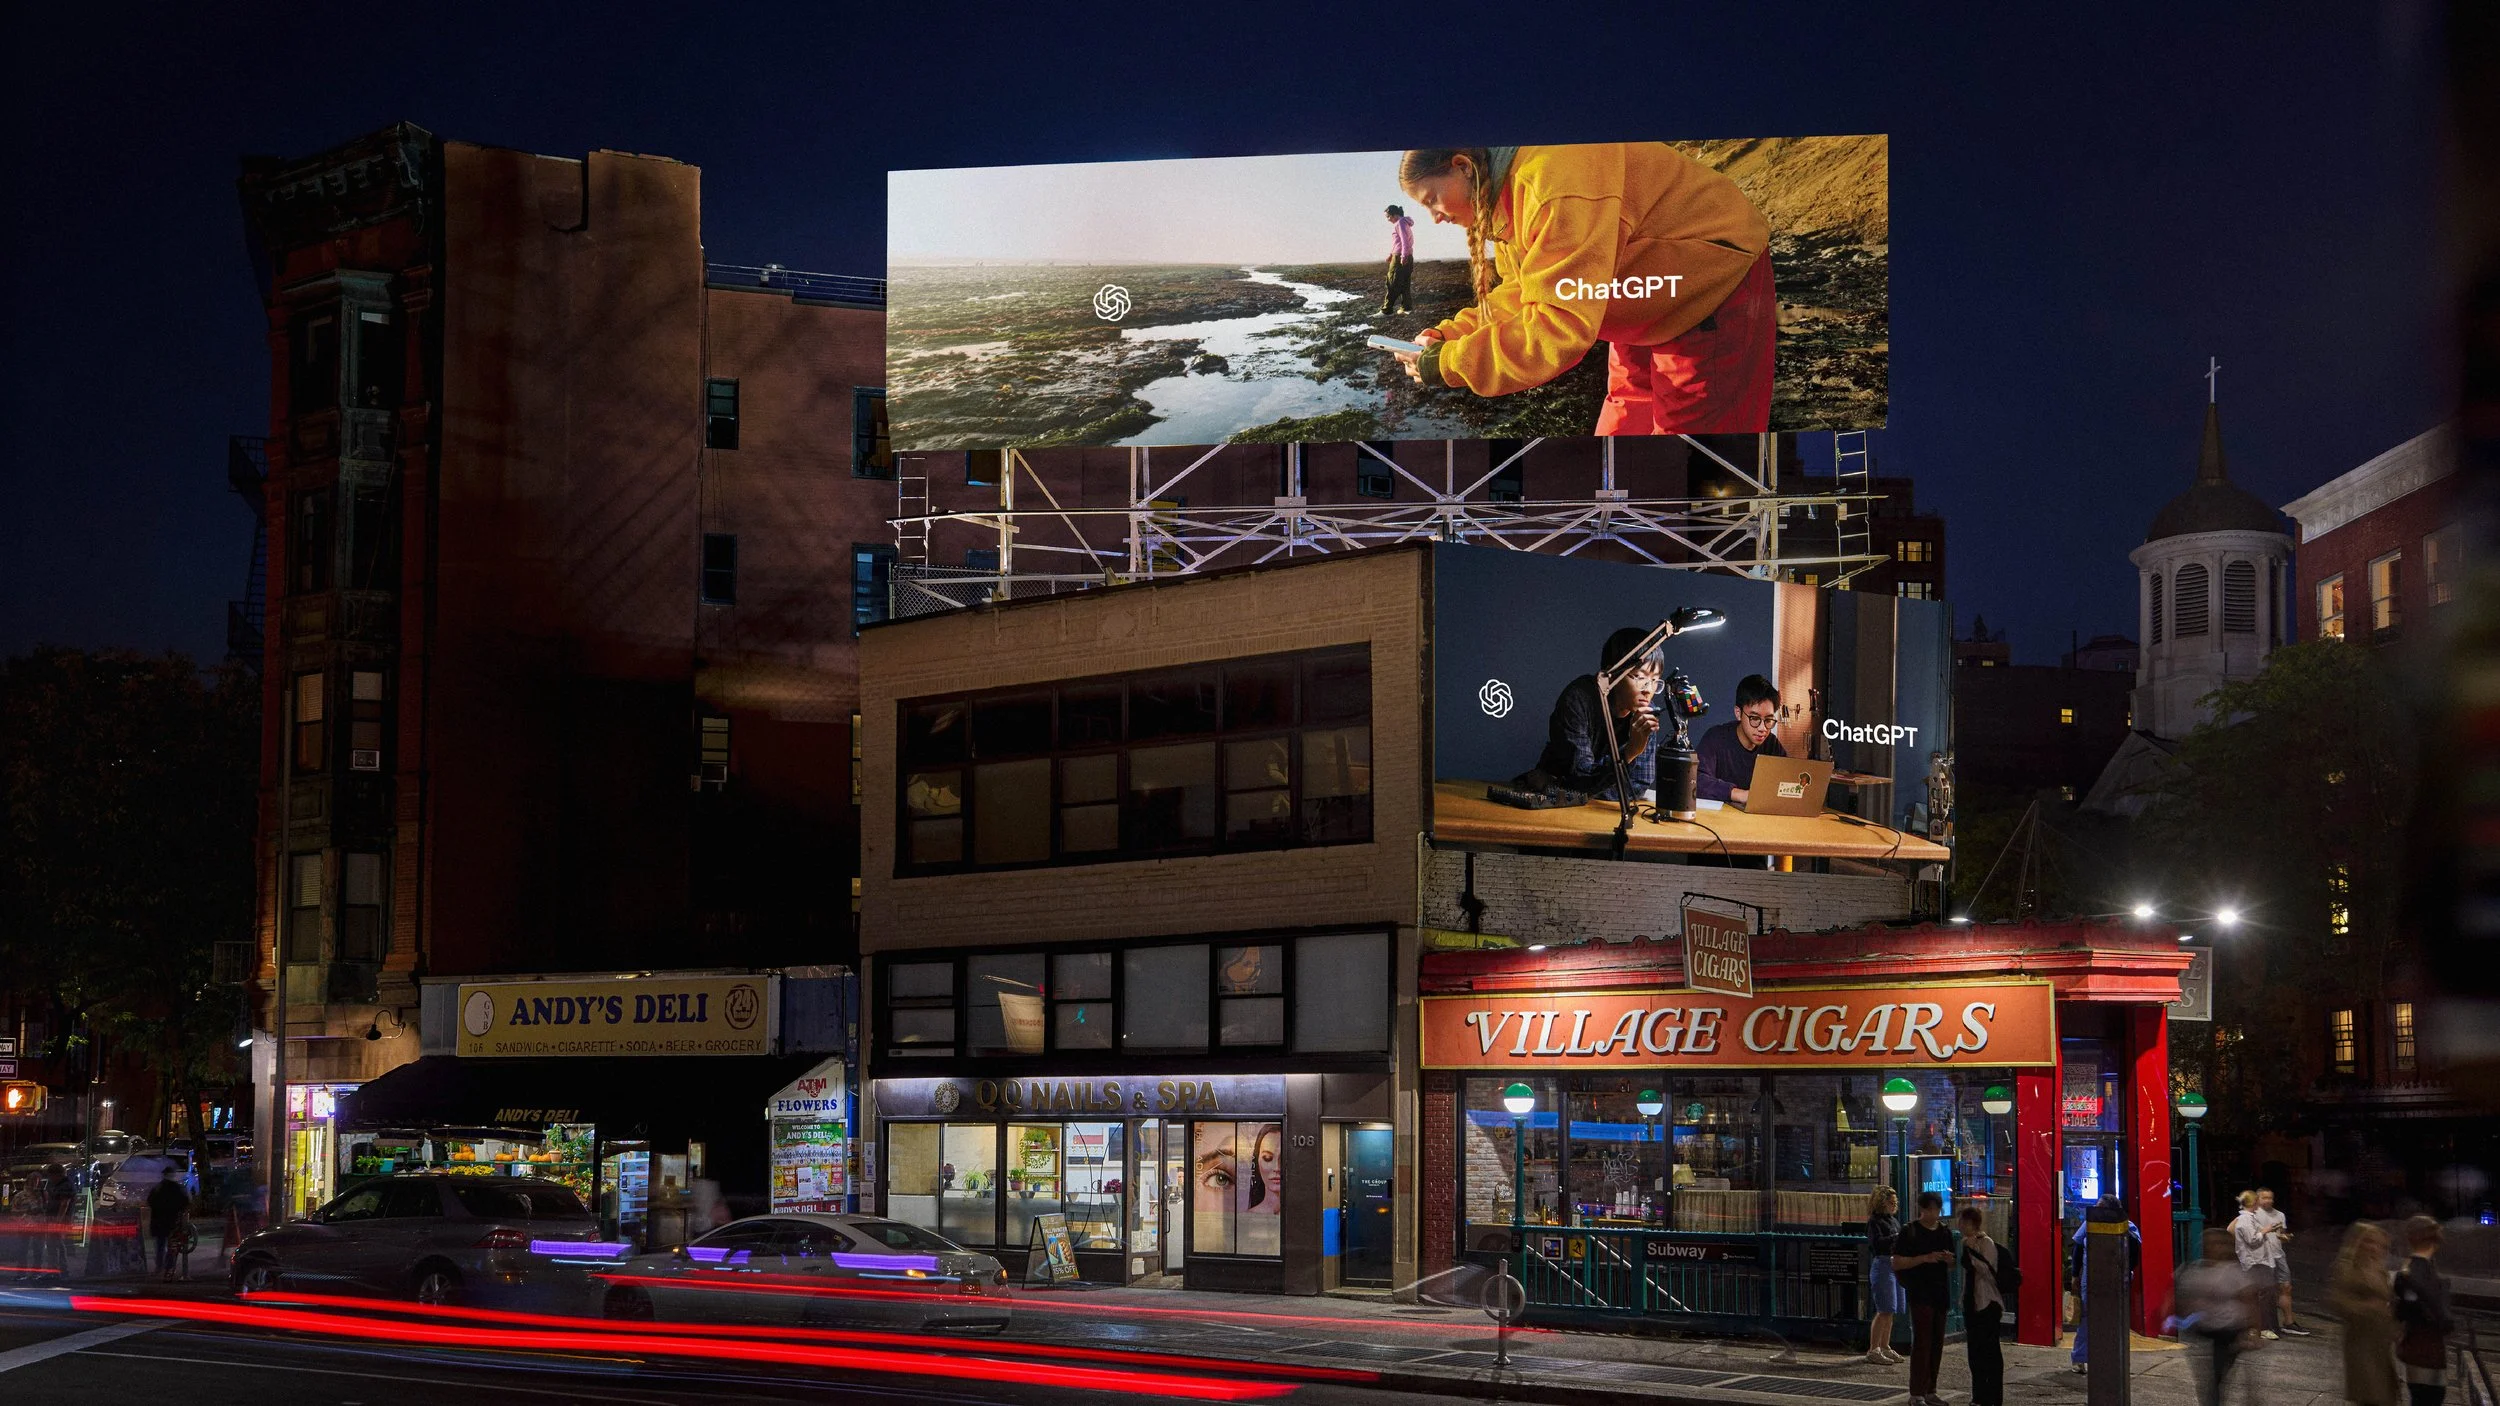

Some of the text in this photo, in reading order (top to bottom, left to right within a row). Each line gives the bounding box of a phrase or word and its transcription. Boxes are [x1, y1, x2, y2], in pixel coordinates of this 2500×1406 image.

[1555, 275, 1683, 301] ChatGPT
[1822, 718, 1918, 748] ChatGPT
[1691, 923, 1746, 954] VILLAGE
[1693, 950, 1747, 988] CIGARS
[509, 992, 709, 1026] ANDY'S DELI
[1467, 1002, 1995, 1058] VILLAGE CIGARS
[495, 1039, 762, 1053] SANDWICH CIGARETTE SODA BEER GROCERY
[797, 1078, 827, 1093] ATM
[1030, 1081, 1122, 1111] NAILS
[1133, 1092, 1148, 1109] &
[1157, 1081, 1220, 1111] SPA
[778, 1099, 838, 1112] FLOWERS
[495, 1108, 579, 1122] ANDY'S DELI
[786, 1131, 812, 1139] ANDY'S
[1292, 1135, 1315, 1147] 108
[1647, 1242, 1707, 1260] Subway
[1052, 1265, 1077, 1275] 15% OFF
